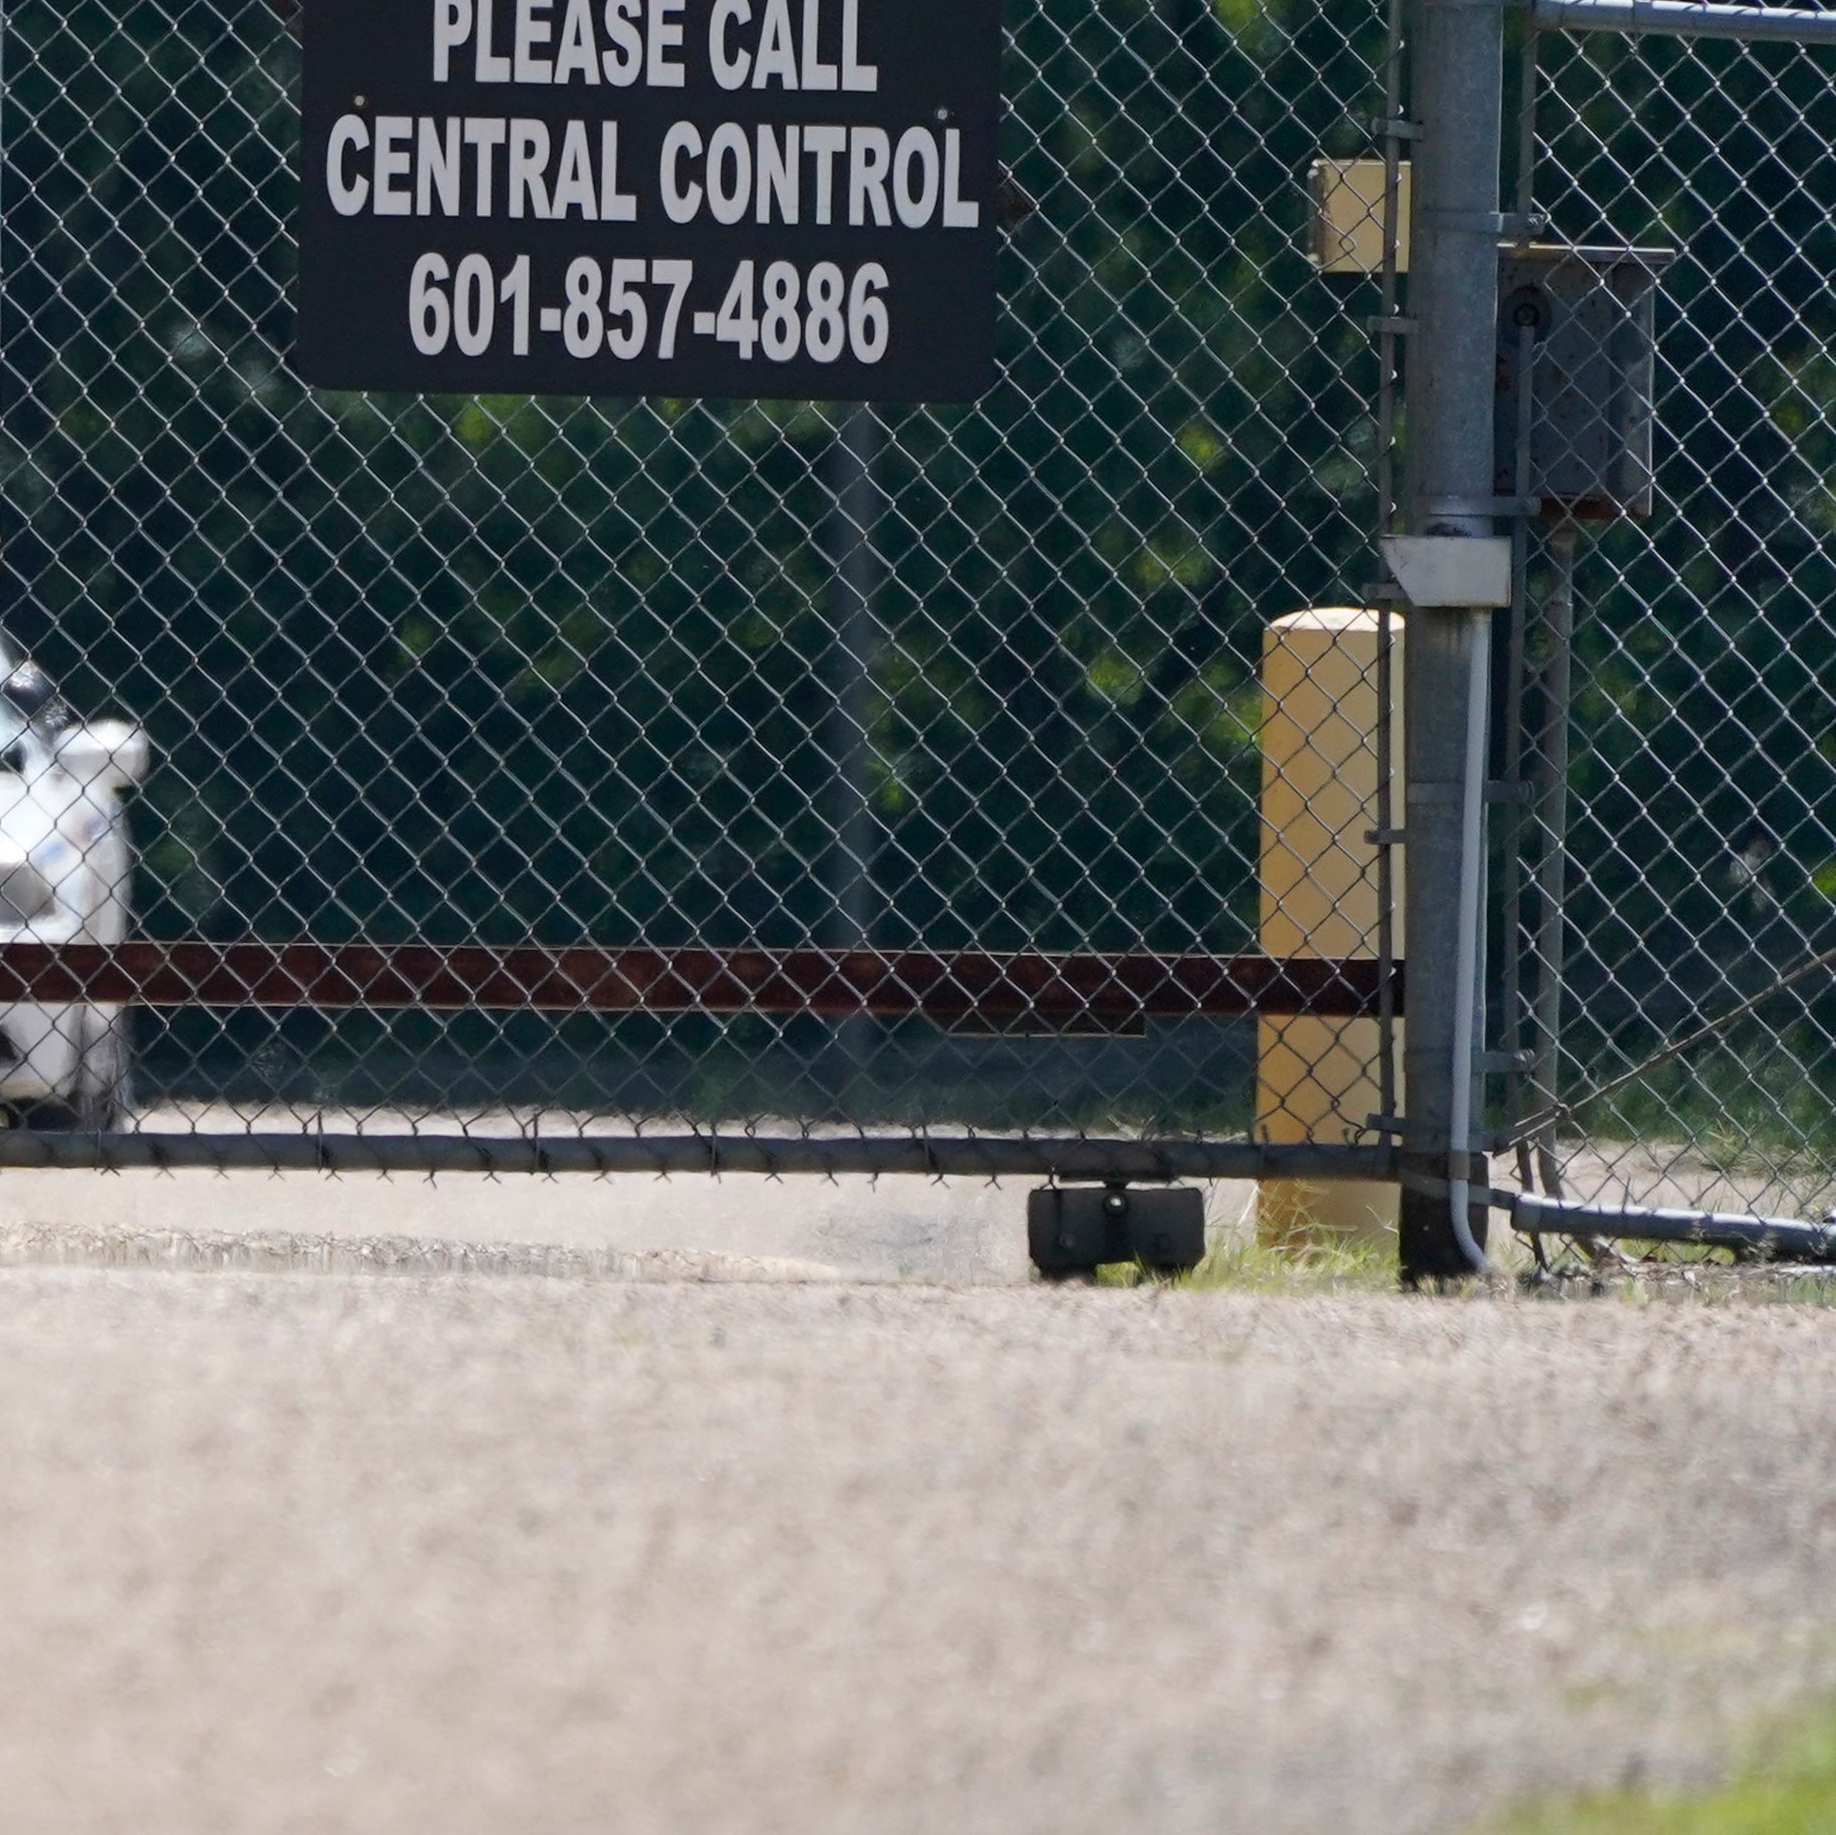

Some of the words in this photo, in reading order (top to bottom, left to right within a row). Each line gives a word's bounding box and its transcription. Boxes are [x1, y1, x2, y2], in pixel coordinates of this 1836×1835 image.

[326, 113, 637, 222] CENTRAL
[659, 120, 979, 229] CONTROL
[408, 252, 889, 364] 601-857-4886
